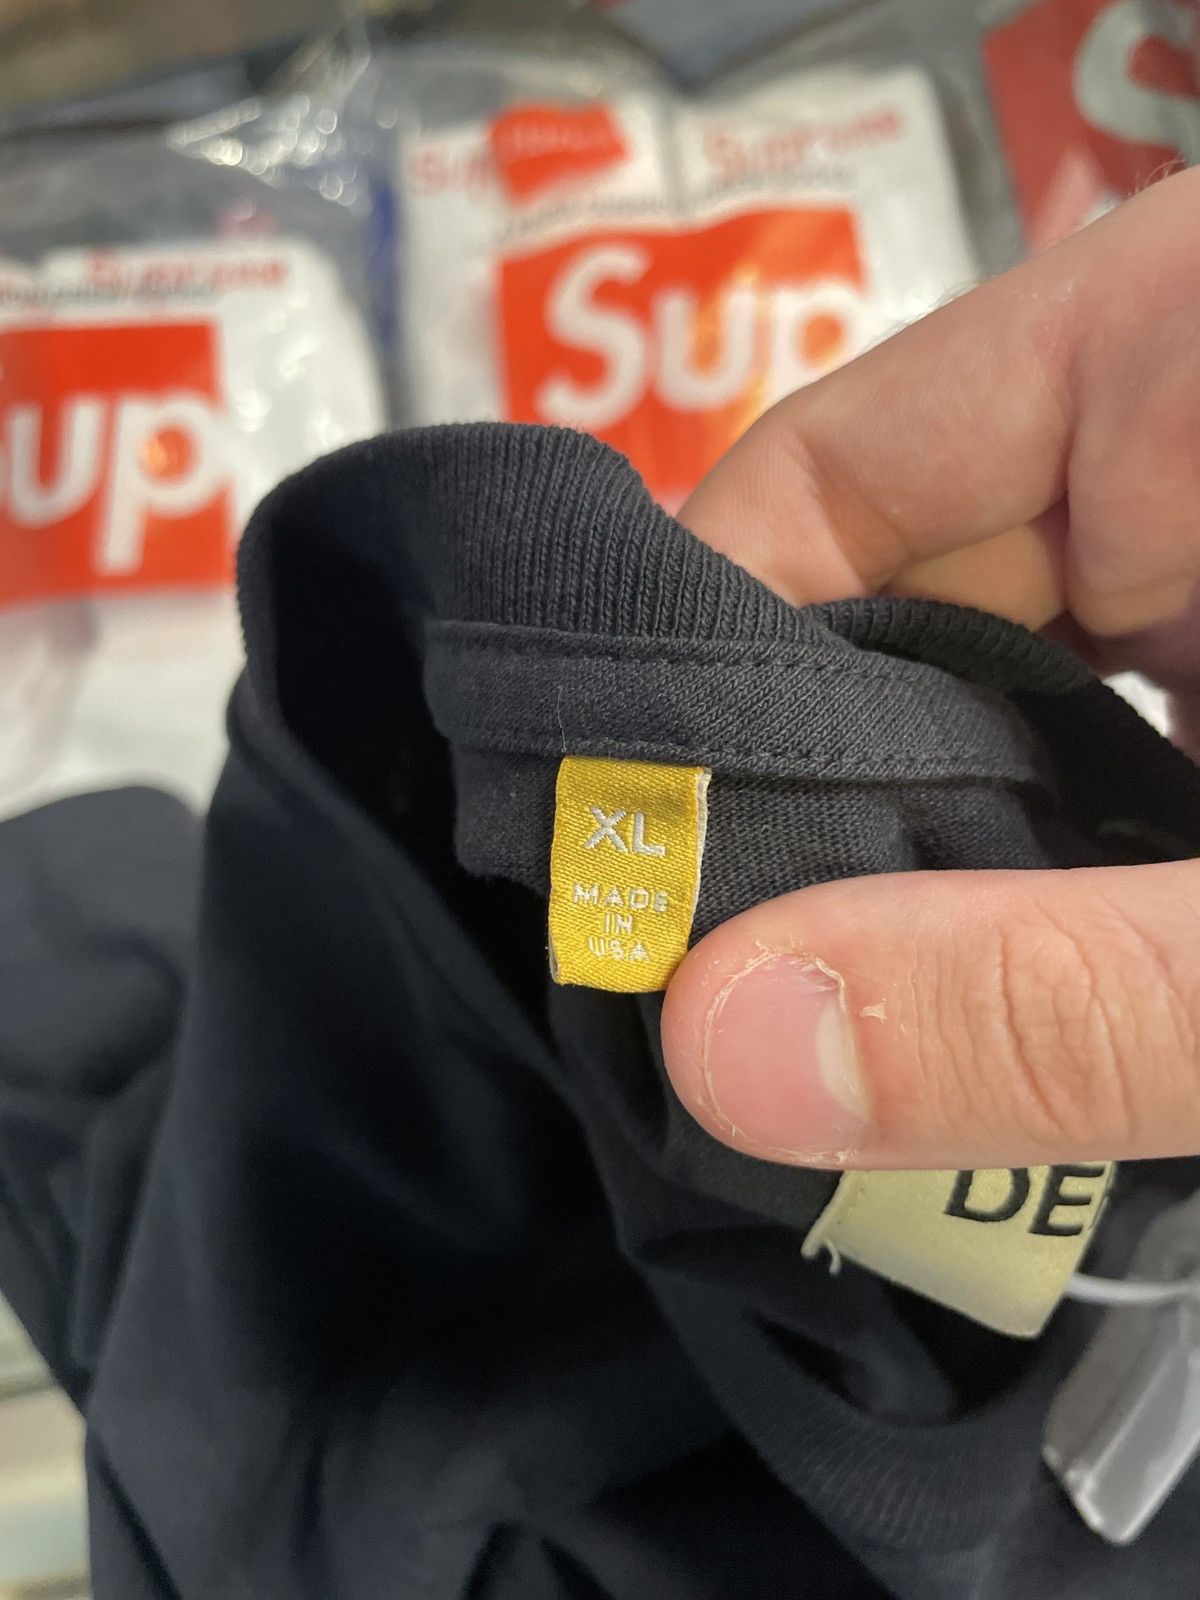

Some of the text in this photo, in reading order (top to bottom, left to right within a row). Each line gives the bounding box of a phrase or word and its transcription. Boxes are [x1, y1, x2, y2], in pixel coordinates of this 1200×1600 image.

[584, 806, 666, 857] XL
[572, 882, 668, 912] MADE
[605, 912, 634, 935] IN
[588, 936, 651, 962] USA
[943, 1164, 1105, 1237] DE
